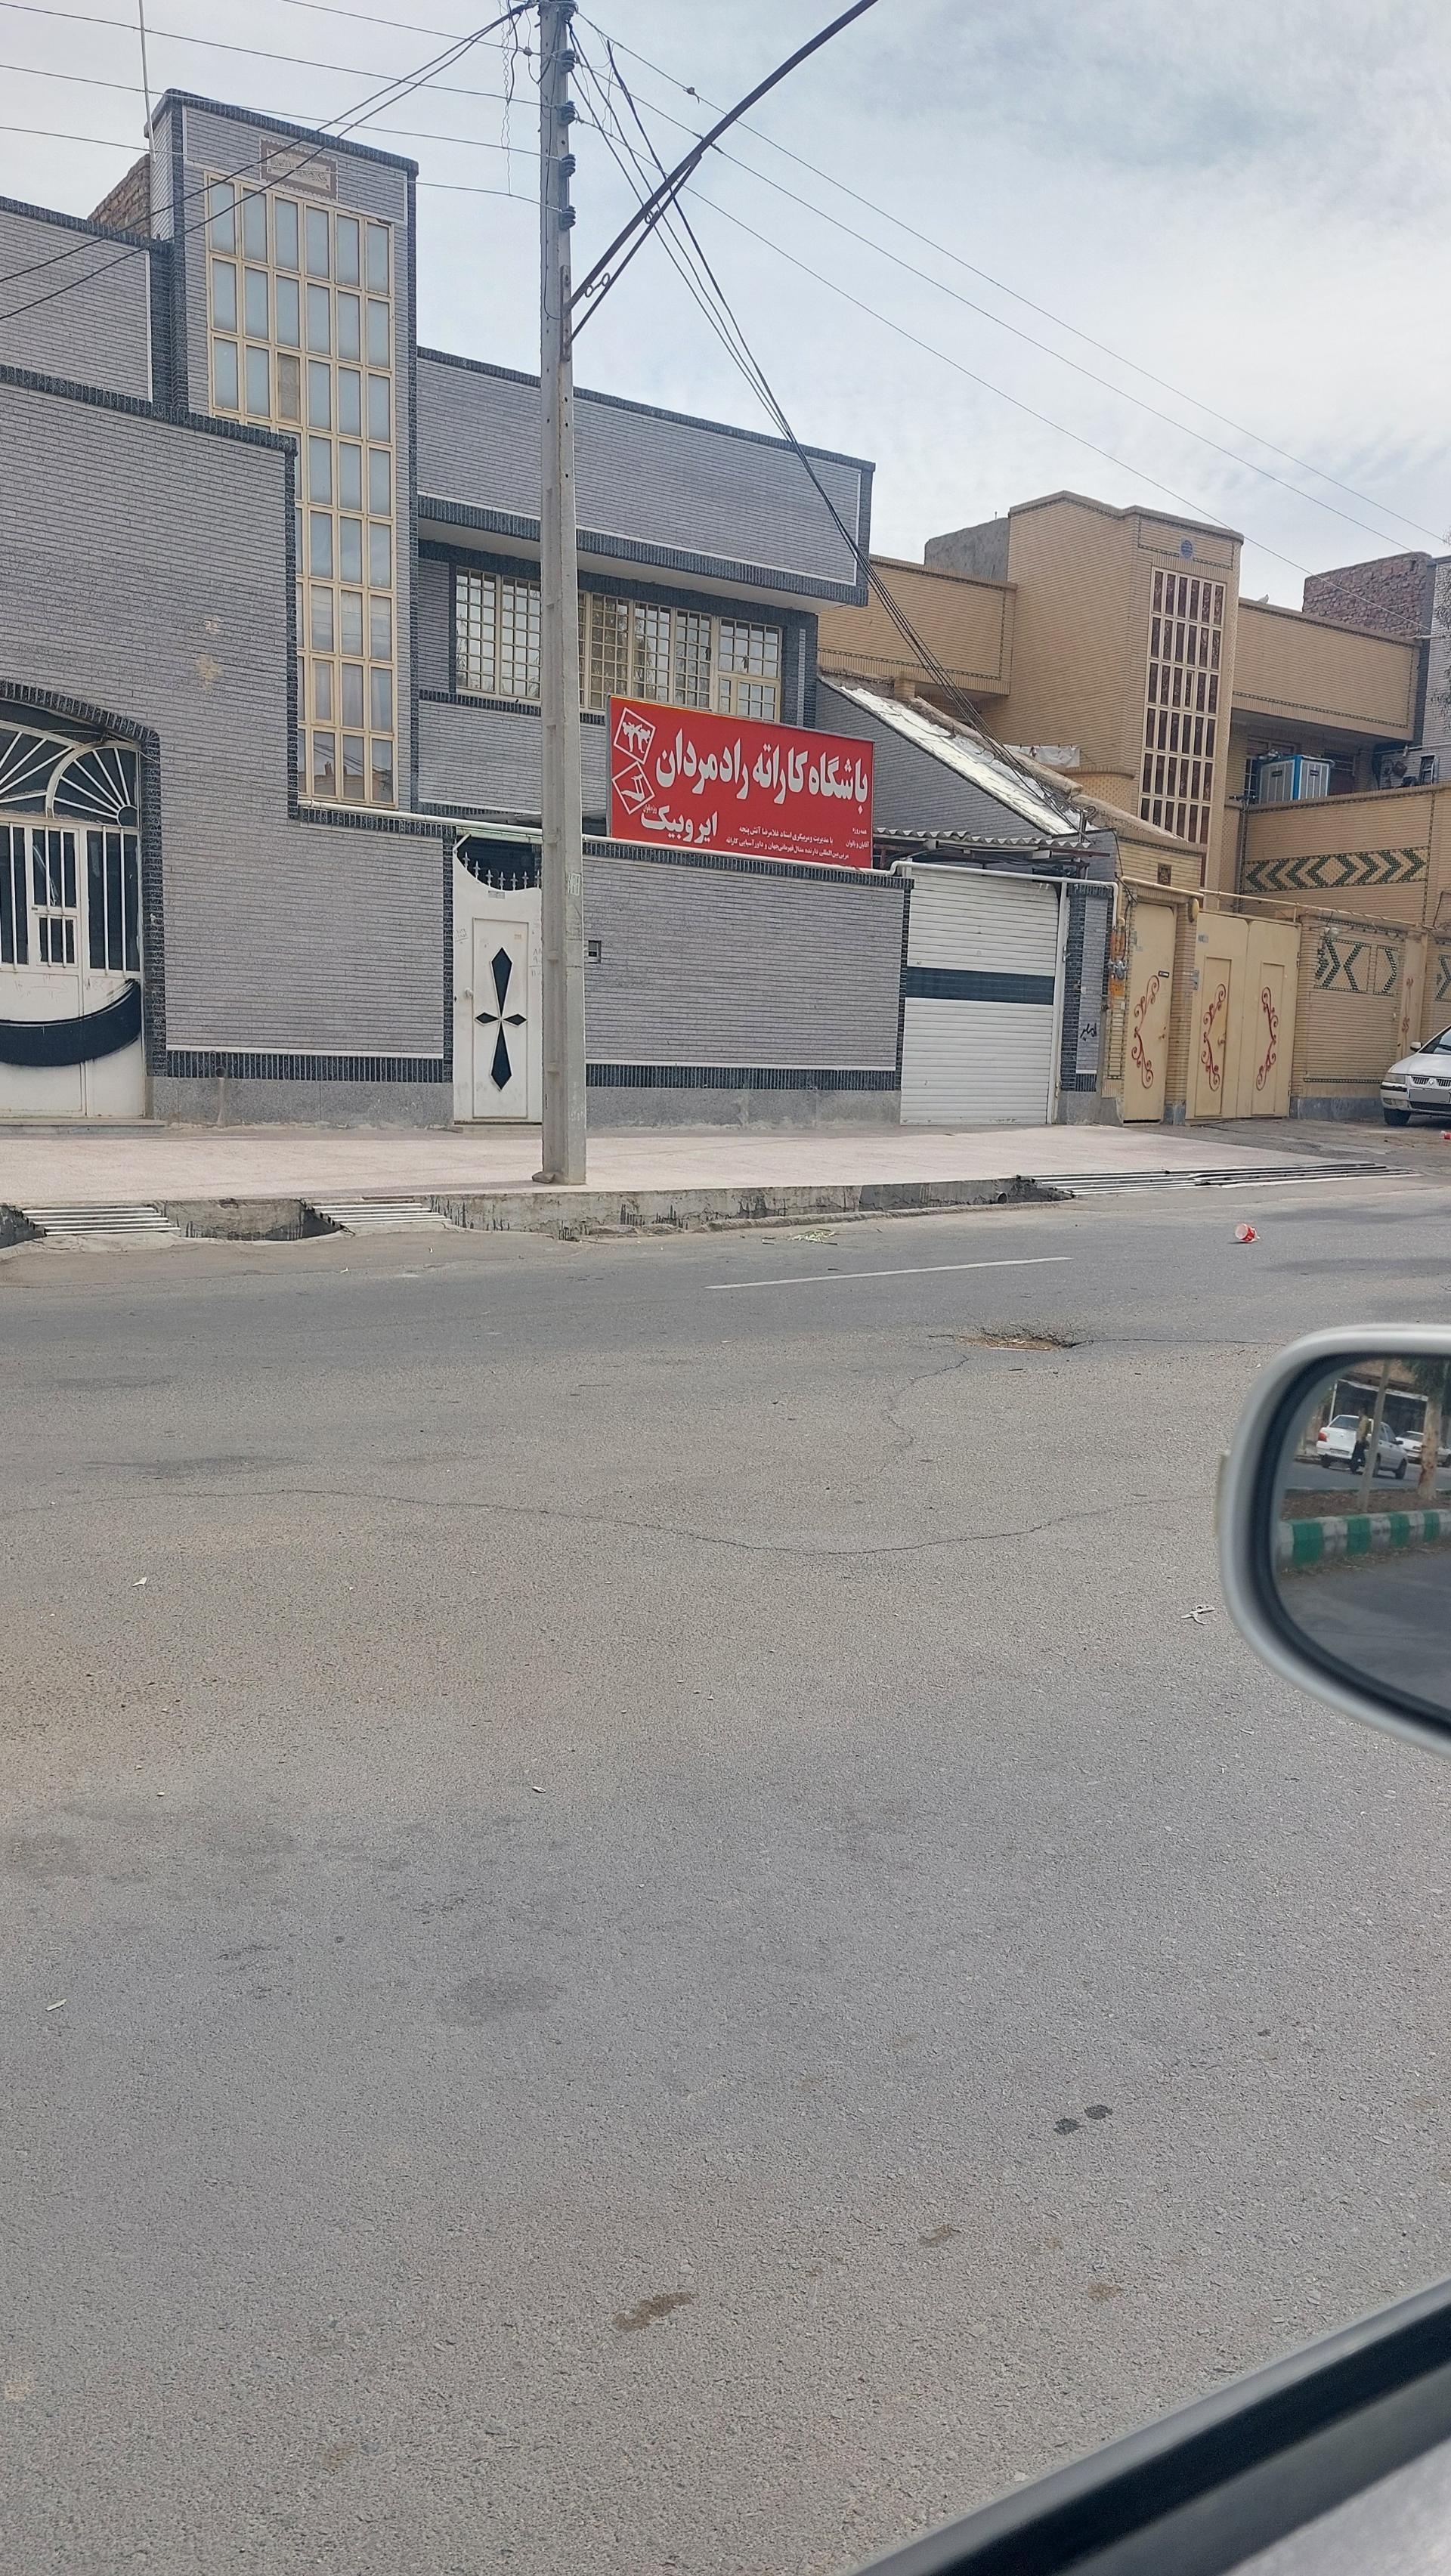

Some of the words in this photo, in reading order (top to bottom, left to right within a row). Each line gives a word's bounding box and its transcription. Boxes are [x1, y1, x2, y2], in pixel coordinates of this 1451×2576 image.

[753, 743, 809, 805] کاراته
[809, 751, 868, 815] باشگاه
[762, 827, 779, 838] غلامرضا
[726, 836, 738, 846] کاراته
[812, 835, 829, 844] مدیریت
